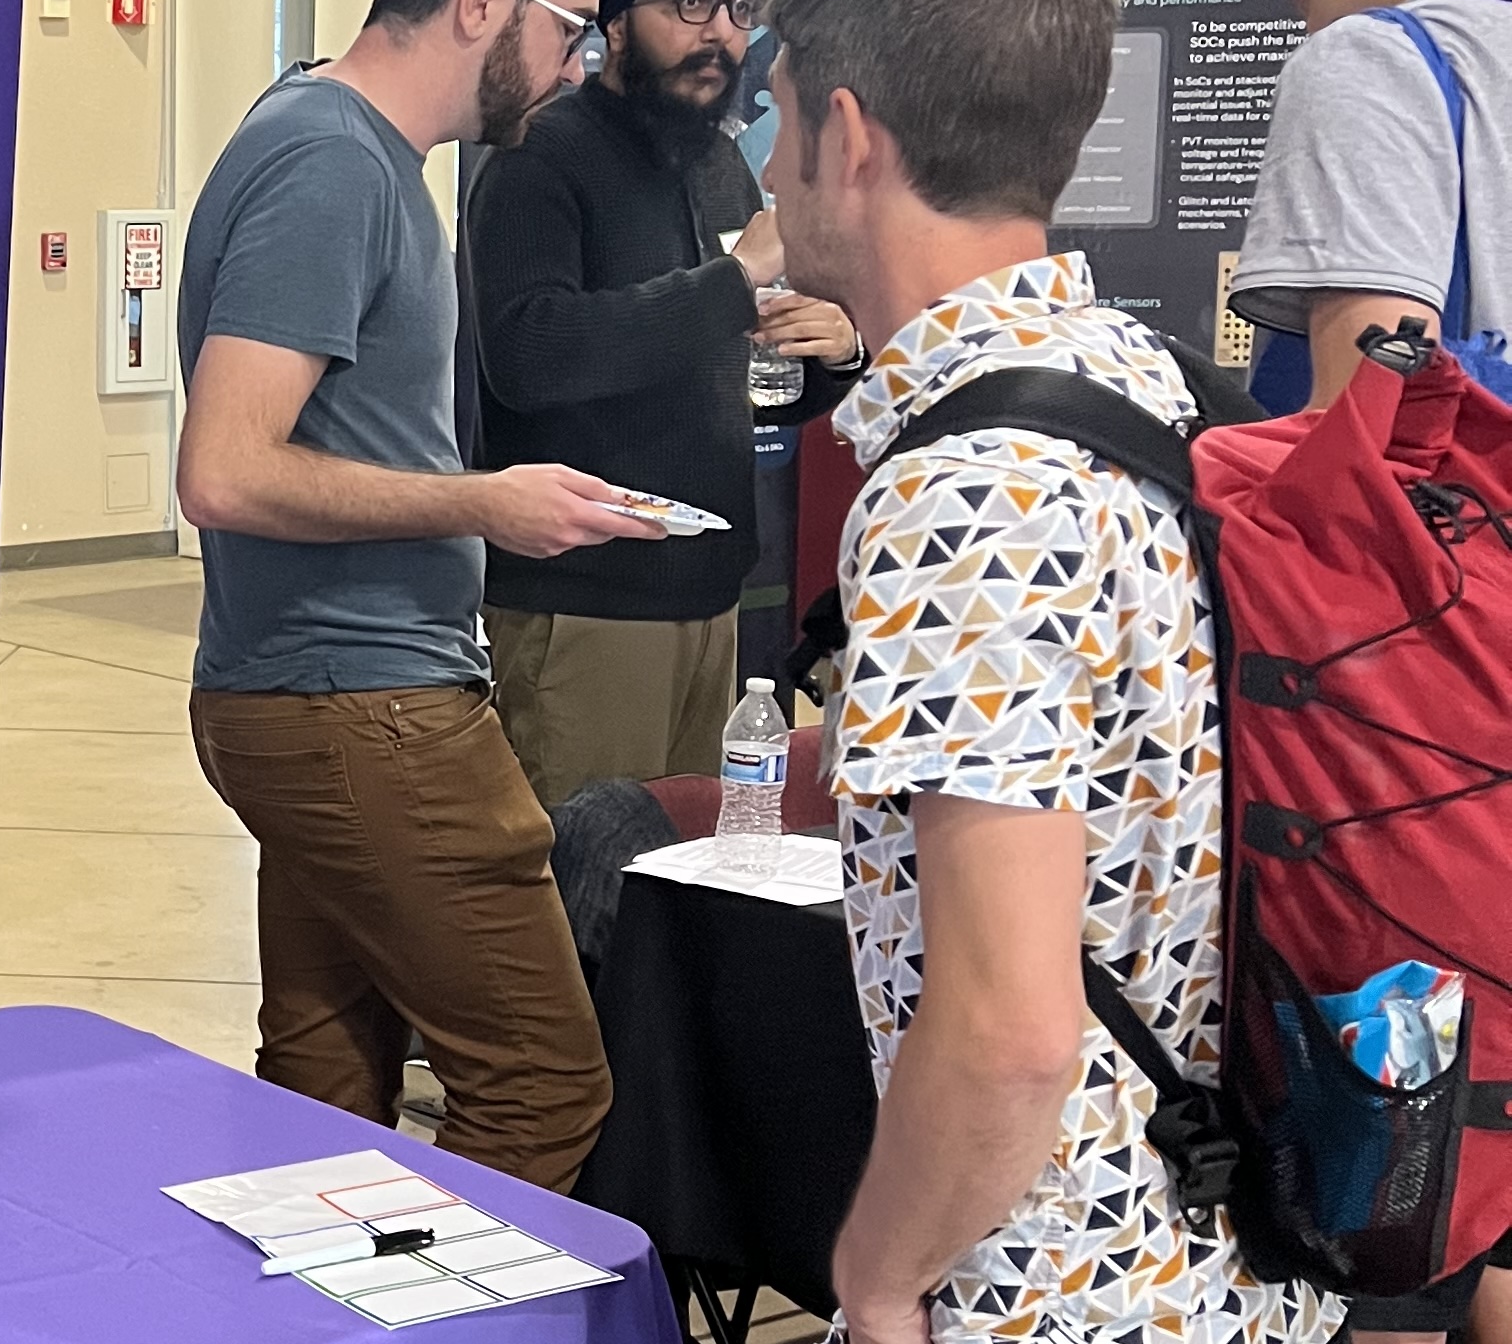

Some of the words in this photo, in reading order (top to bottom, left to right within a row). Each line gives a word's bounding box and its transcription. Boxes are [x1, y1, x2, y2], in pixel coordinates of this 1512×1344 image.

[1191, 21, 1207, 33] To
[1209, 21, 1227, 33] be
[1229, 18, 1307, 34] competitive
[1189, 36, 1225, 48] SOCs
[1227, 35, 1260, 49] push
[1263, 34, 1284, 46] the
[1189, 53, 1204, 64] to
[1205, 50, 1255, 63] achieve
[1257, 49, 1292, 62] maxi
[1113, 296, 1162, 308] Sensors
